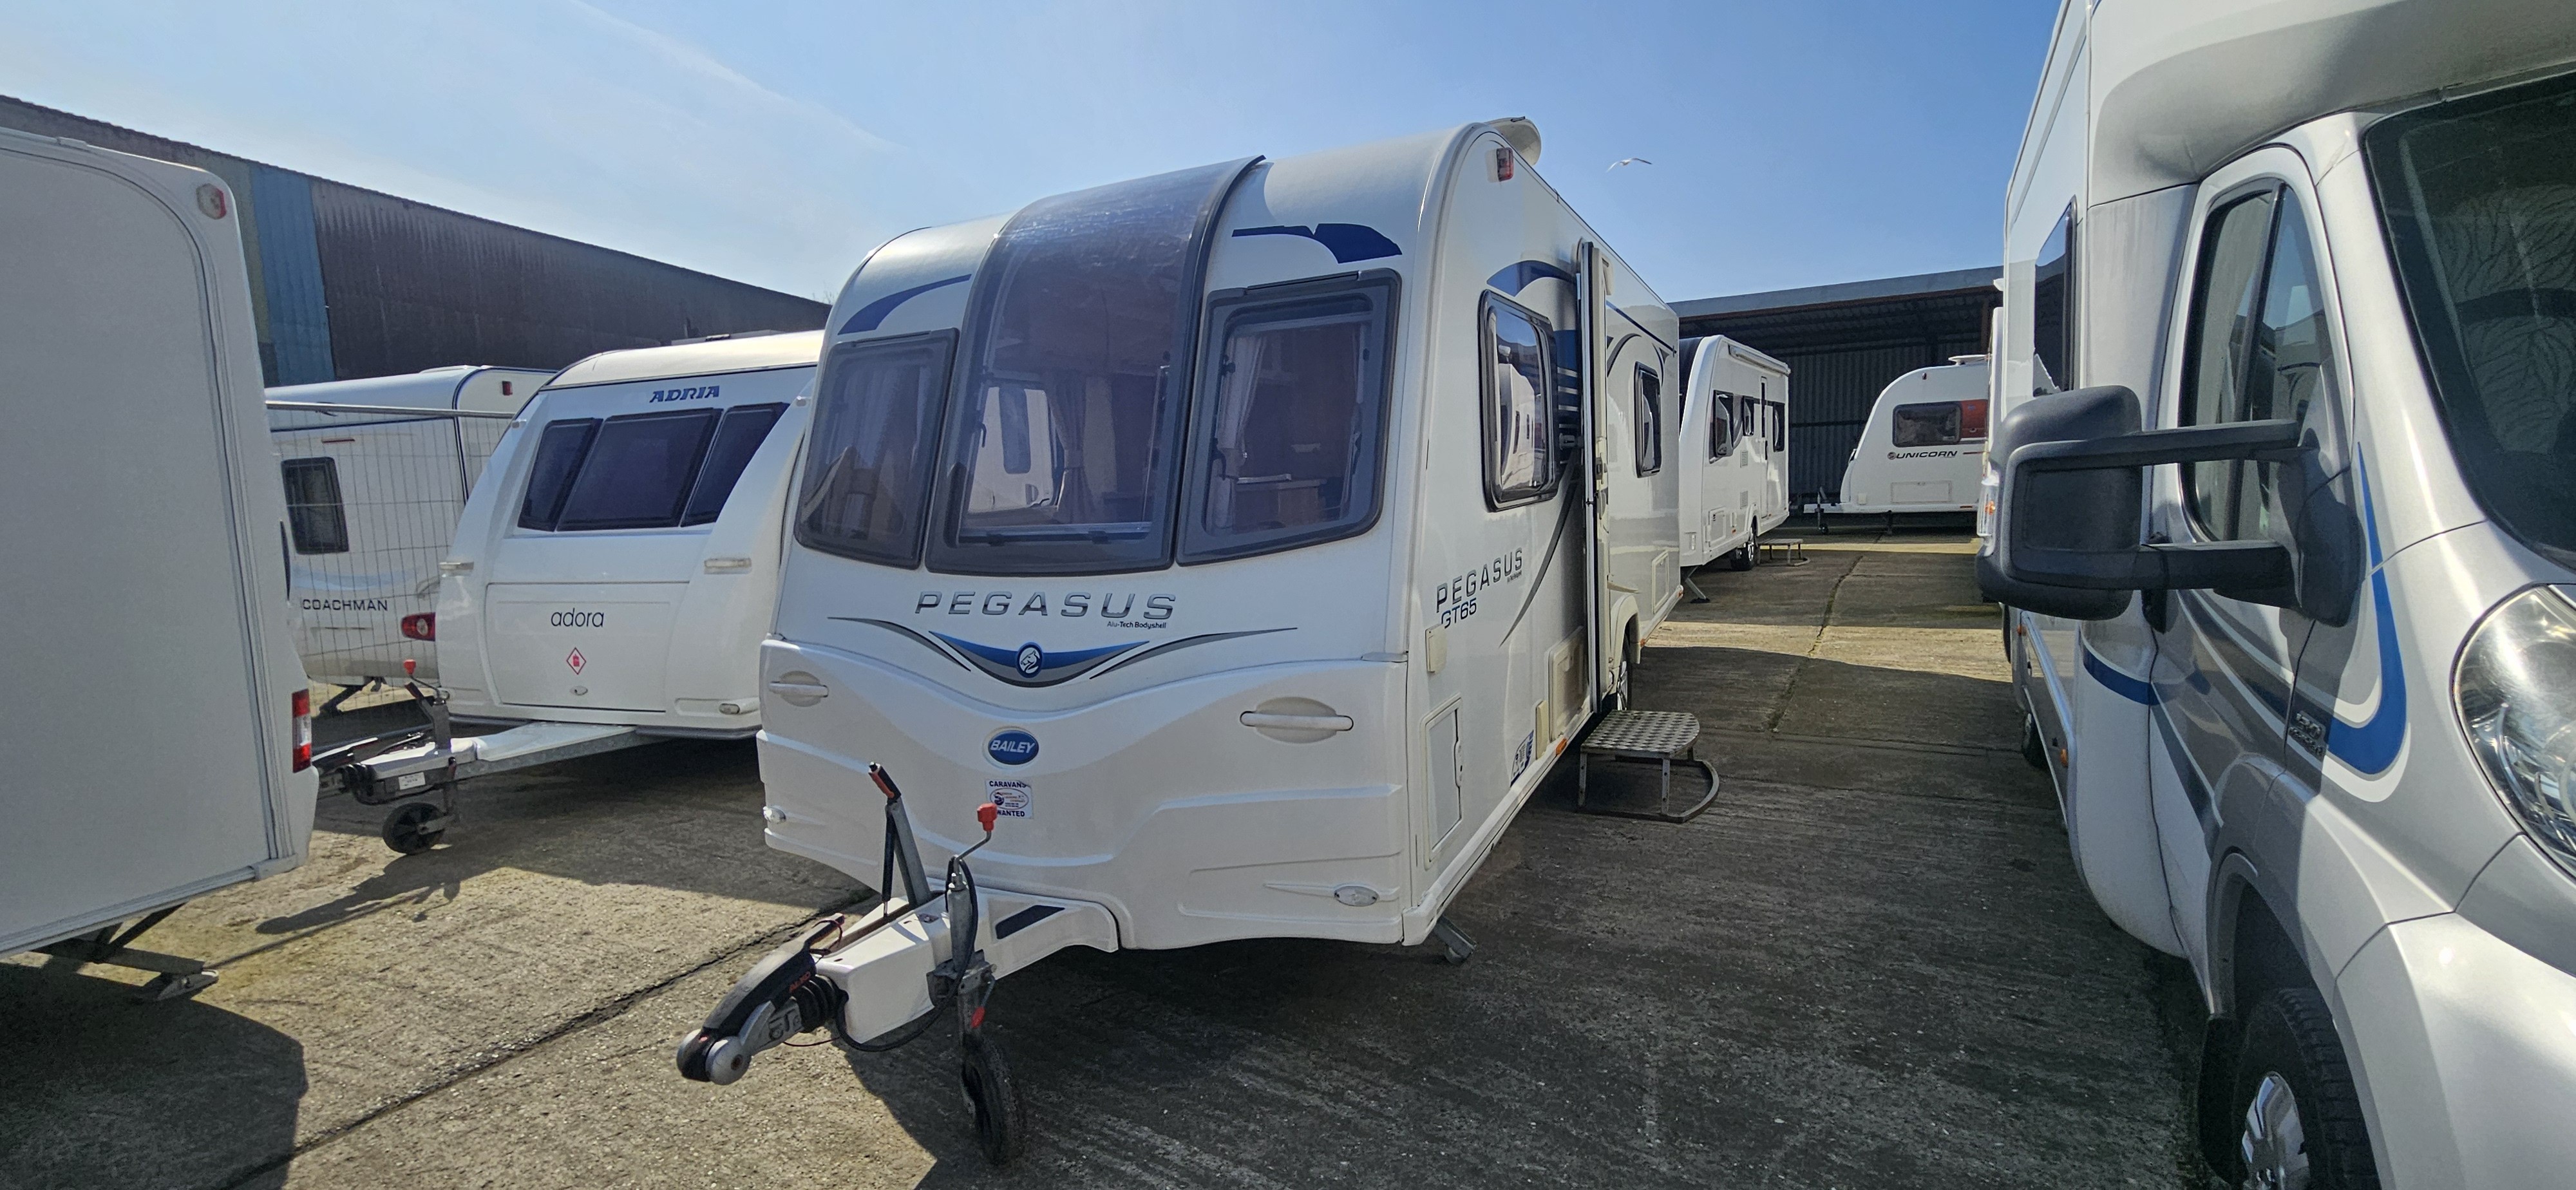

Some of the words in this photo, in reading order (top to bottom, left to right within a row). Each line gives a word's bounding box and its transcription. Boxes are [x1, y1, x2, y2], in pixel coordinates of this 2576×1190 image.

[649, 386, 719, 402] ADRIA
[1896, 451, 1958, 459] UNICORN
[1436, 547, 1522, 613] PEGASUS
[303, 599, 388, 611] COACHMAN
[914, 590, 1176, 619] PEGASUS
[1441, 598, 1477, 629] GT65
[551, 607, 604, 627] adora
[990, 739, 1035, 753] BAILEY
